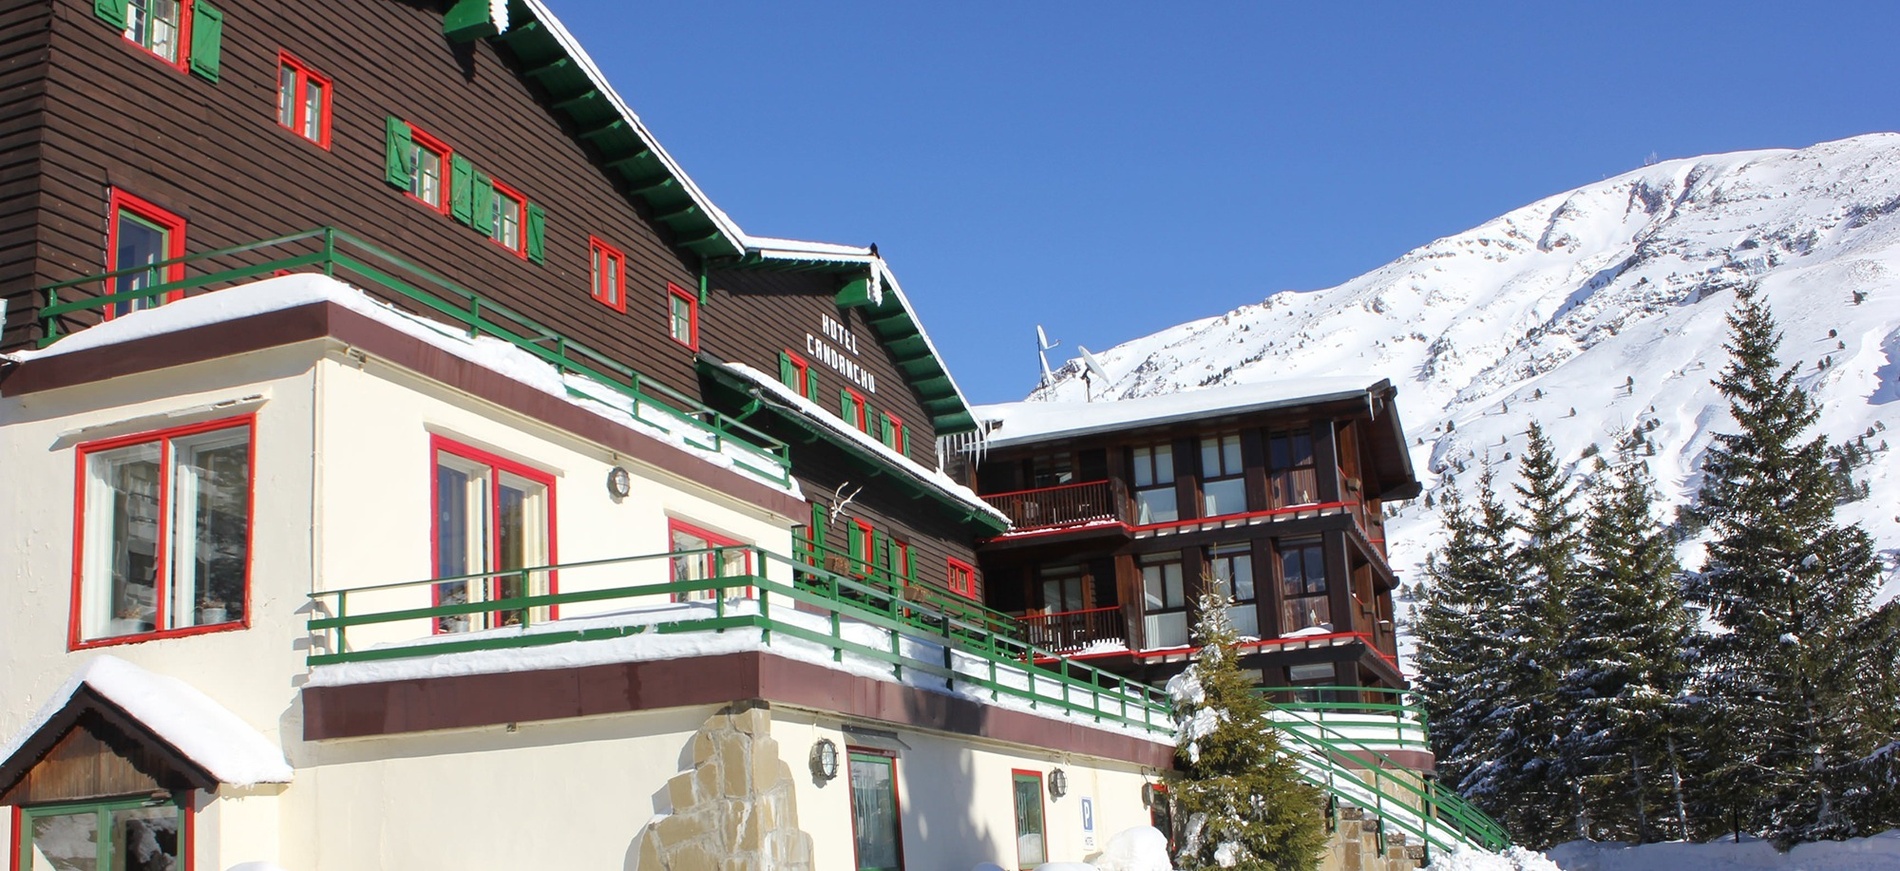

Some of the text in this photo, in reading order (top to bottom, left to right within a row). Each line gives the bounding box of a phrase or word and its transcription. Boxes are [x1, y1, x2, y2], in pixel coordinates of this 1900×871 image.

[822, 313, 859, 356] HOTEL
[806, 333, 876, 394] CANDANCHU
[1083, 801, 1090, 828] P
